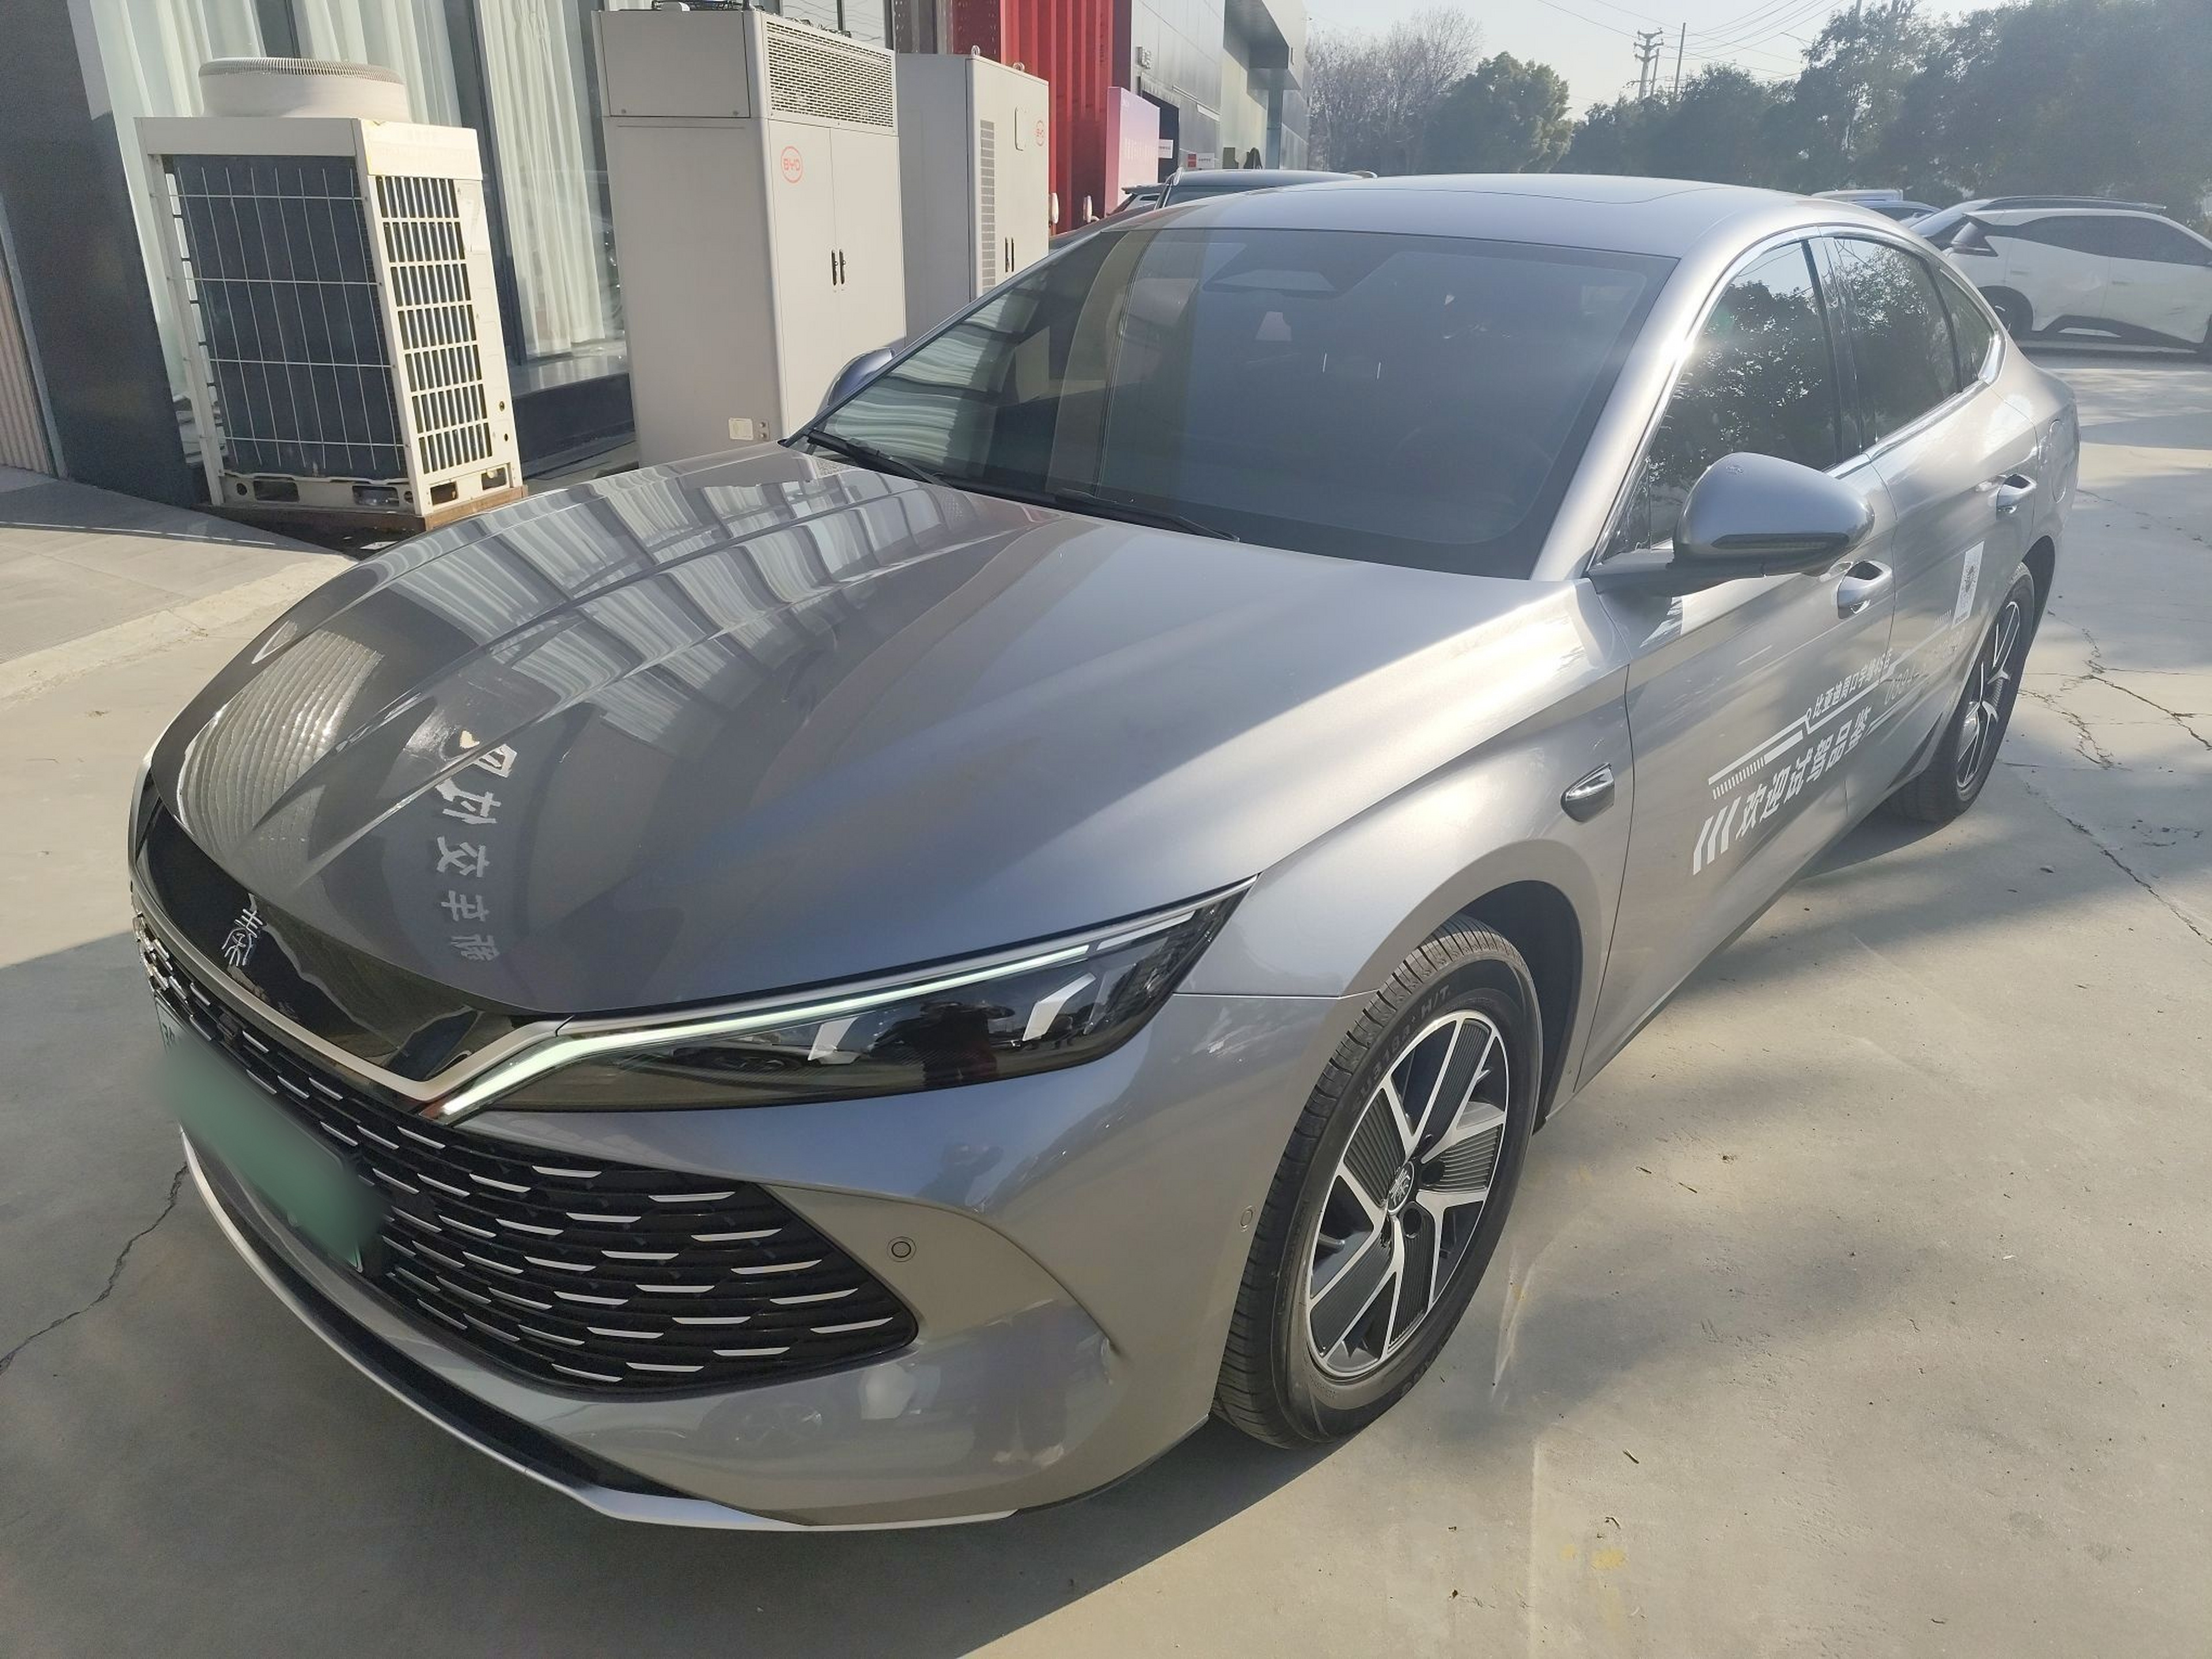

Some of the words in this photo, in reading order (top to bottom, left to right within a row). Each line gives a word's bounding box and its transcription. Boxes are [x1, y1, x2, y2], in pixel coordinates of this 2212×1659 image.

[1735, 705, 1872, 840] 欢迎试驾品鉴
